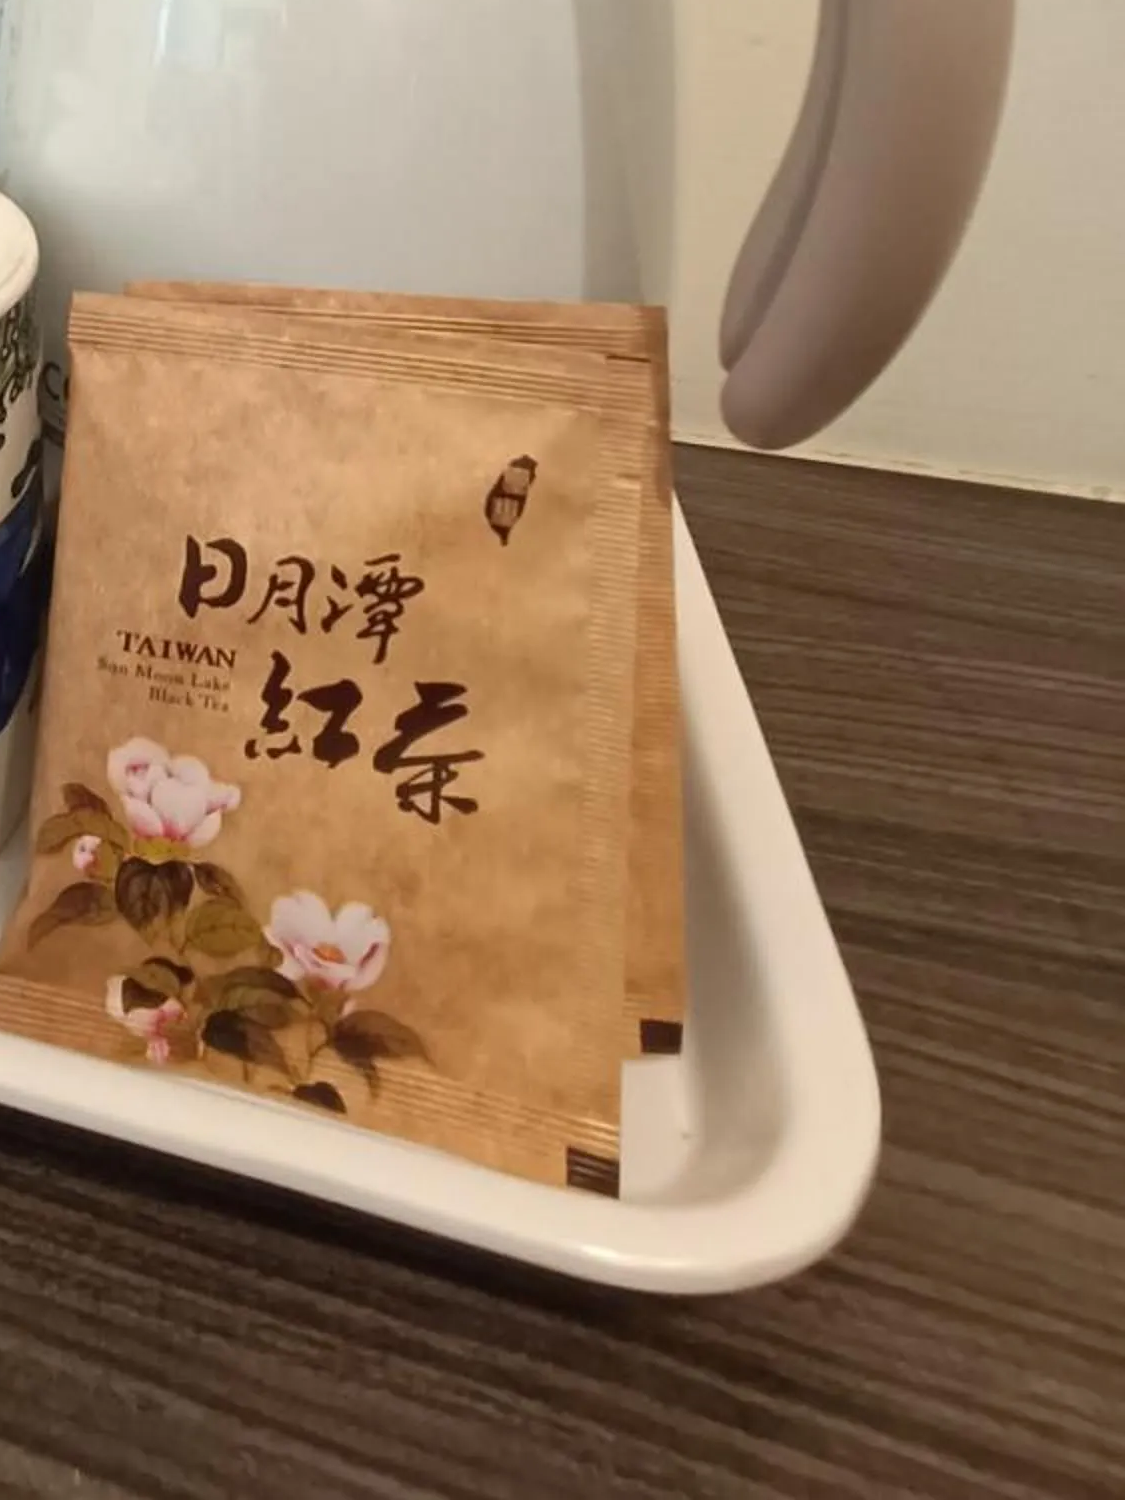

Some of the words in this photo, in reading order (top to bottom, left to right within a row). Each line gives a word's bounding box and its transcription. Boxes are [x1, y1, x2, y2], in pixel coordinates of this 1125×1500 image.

[178, 534, 425, 664] 日月潭
[116, 629, 237, 670] TAIWAN
[190, 671, 231, 692] Lake
